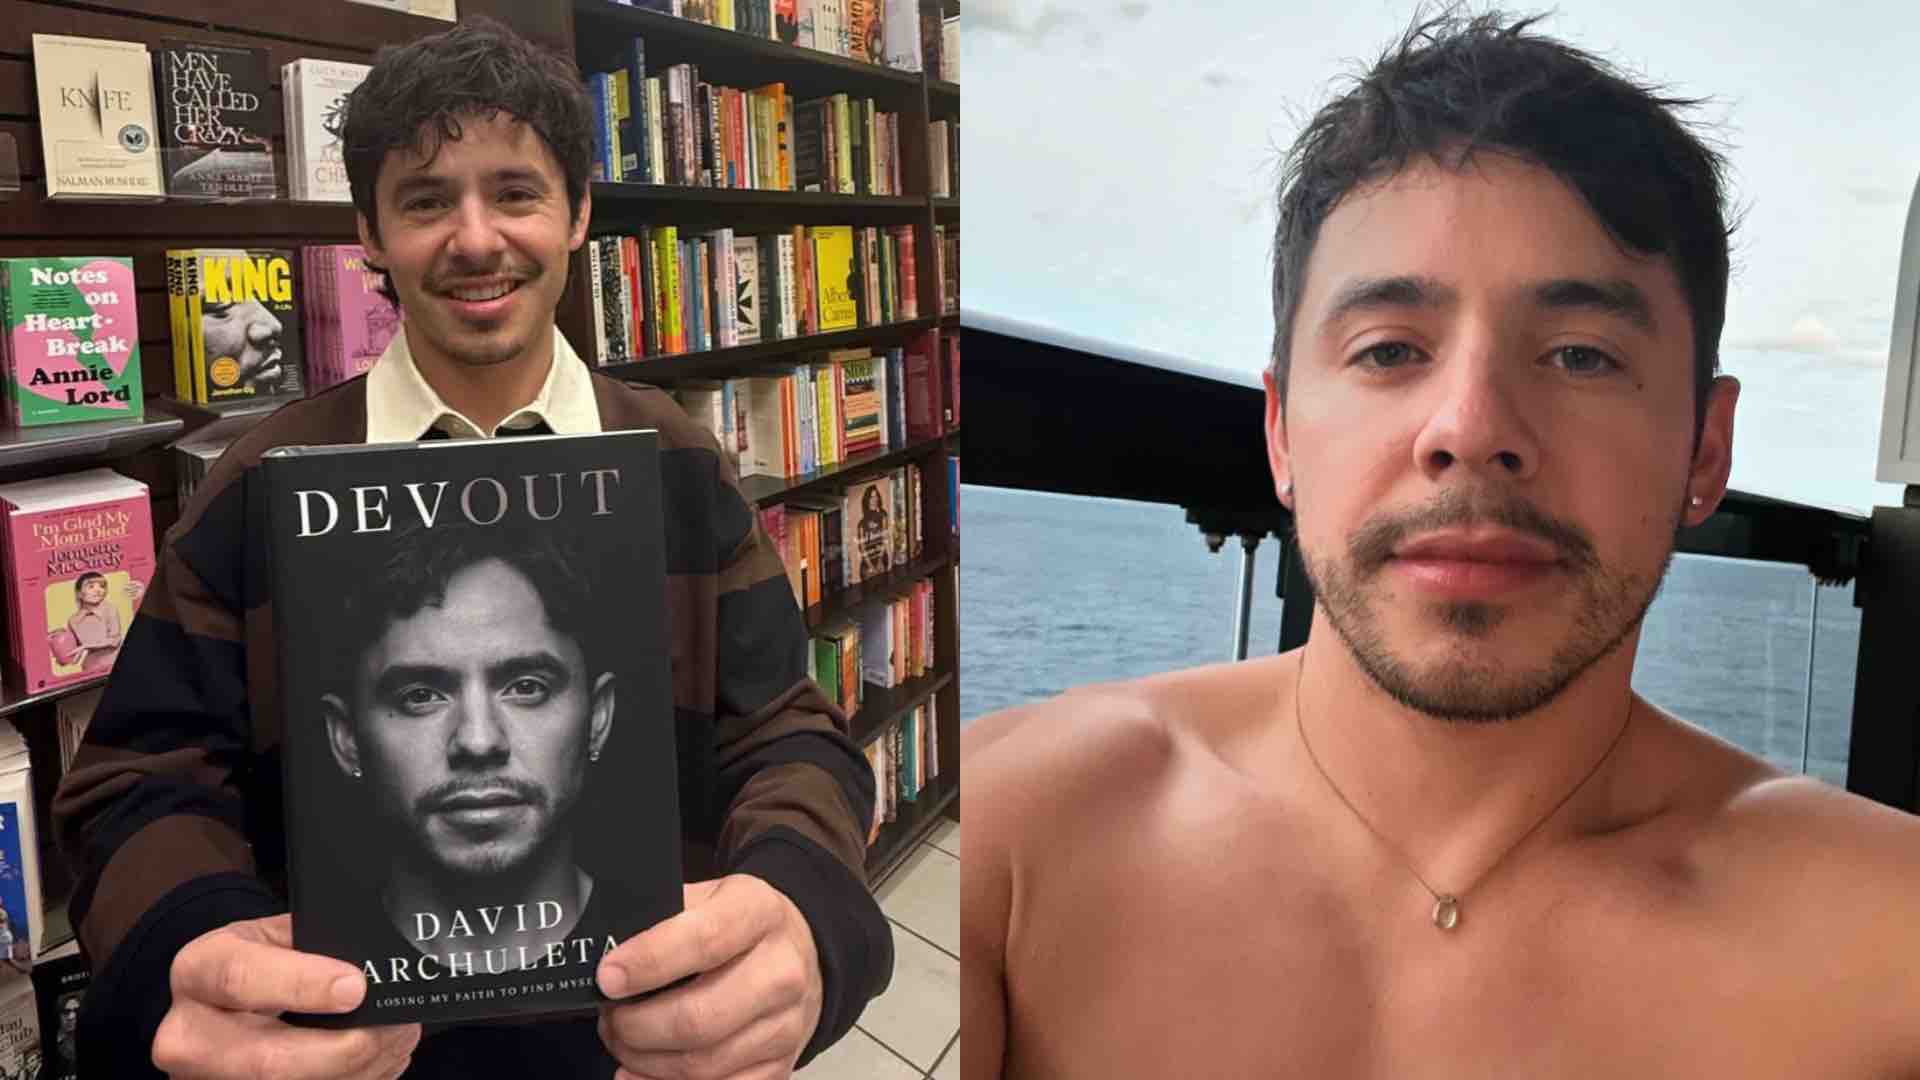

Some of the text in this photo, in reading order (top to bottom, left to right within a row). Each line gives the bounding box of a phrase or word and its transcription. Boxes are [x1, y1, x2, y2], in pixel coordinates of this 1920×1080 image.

[169, 50, 217, 71] MEN
[172, 67, 231, 91] HAVE
[172, 87, 259, 111] CALLED
[175, 106, 223, 128] HER
[174, 124, 244, 145] CRAZY
[30, 267, 108, 285] Notes
[187, 257, 198, 295] KING
[203, 256, 293, 304] KING
[84, 290, 119, 304] on
[24, 312, 113, 332] Heart-
[46, 336, 128, 357] Break
[30, 364, 113, 386] Annie
[65, 385, 131, 405] Lord
[293, 468, 622, 537] DEVOUT
[32, 522, 60, 537] I'm
[63, 513, 102, 532] Glad
[105, 511, 132, 524] My
[40, 522, 127, 551] Mom Died
[414, 900, 563, 941] DAVID
[363, 935, 619, 985] ARCHULETA
[376, 994, 425, 1008] LOSING
[431, 992, 449, 1004] MY
[456, 989, 495, 1002] FAITH
[501, 986, 518, 998] TO
[522, 983, 552, 995] FIND
